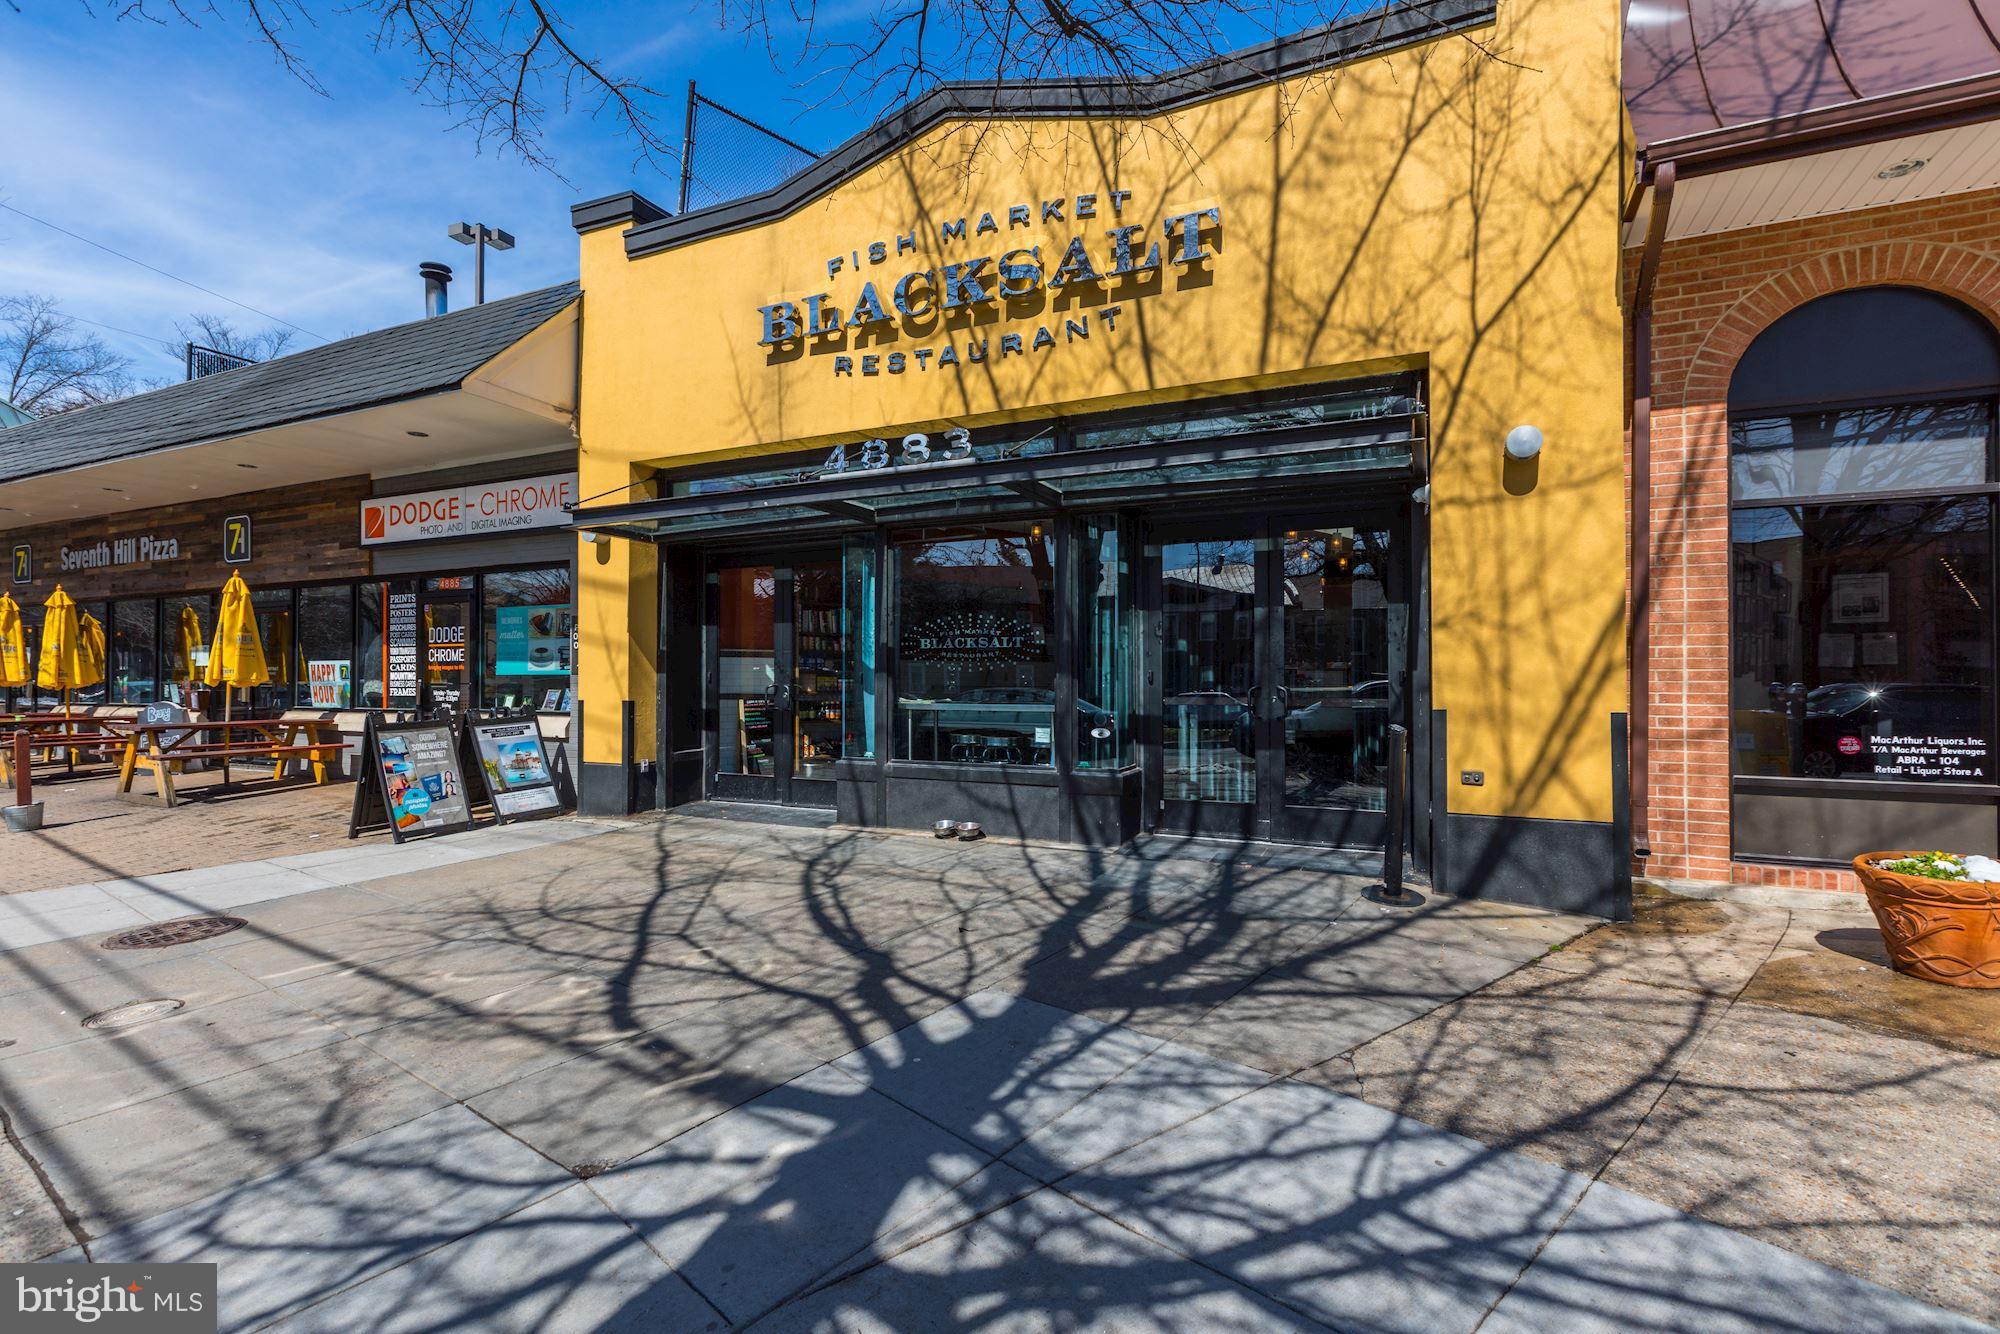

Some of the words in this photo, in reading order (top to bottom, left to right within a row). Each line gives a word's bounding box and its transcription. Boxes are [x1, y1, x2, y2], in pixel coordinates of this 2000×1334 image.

[827, 229, 918, 281] FISH
[942, 189, 1132, 245] MARKET
[756, 207, 1221, 347] BLACKSALT
[834, 305, 1122, 377] RESTAURANT
[823, 426, 974, 474] 4883
[389, 496, 460, 526] DODGE
[480, 482, 570, 516] CHROME
[420, 524, 443, 536] PHOTO
[447, 522, 464, 532] AND
[471, 518, 498, 531] DIGITAL
[499, 514, 533, 528] IMAGING
[61, 540, 111, 571] Seventh
[113, 536, 136, 565] Hill
[140, 535, 179, 562] Pizza
[440, 578, 460, 589] 4885
[389, 593, 416, 604] PRINTS
[389, 609, 416, 618] POSTERS
[389, 623, 416, 632] BROCHURES
[939, 628, 960, 637] FISH
[964, 628, 1002, 636] MARKET
[428, 626, 465, 644] DODGE
[919, 635, 1025, 650] BLACKSALT
[389, 655, 416, 664] PASSPORTS
[428, 648, 465, 662] CHROME
[941, 650, 1001, 658] RESTAURANT
[311, 664, 336, 682] HAPPY
[389, 663, 416, 672] CARDS
[389, 671, 416, 681] MOUNTING
[312, 685, 336, 704] HOUR
[389, 687, 416, 697] FRAMES
[147, 706, 171, 722] Buy
[411, 740, 448, 752] SOMEWHERE
[1870, 735, 1924, 745] MacArthur
[1968, 736, 1987, 746] Inc.
[417, 749, 447, 760] AMAZING?
[1871, 745, 1889, 754] T/A
[1891, 745, 1938, 755] MacArthur
[1941, 746, 1986, 757] Beverages
[1896, 756, 1926, 765] ABRA
[1939, 756, 1960, 766] 104
[1874, 765, 1902, 774] Retail
[1911, 766, 1942, 776] Liquor
[1943, 767, 1971, 777] Store
[1973, 768, 1984, 777] A
